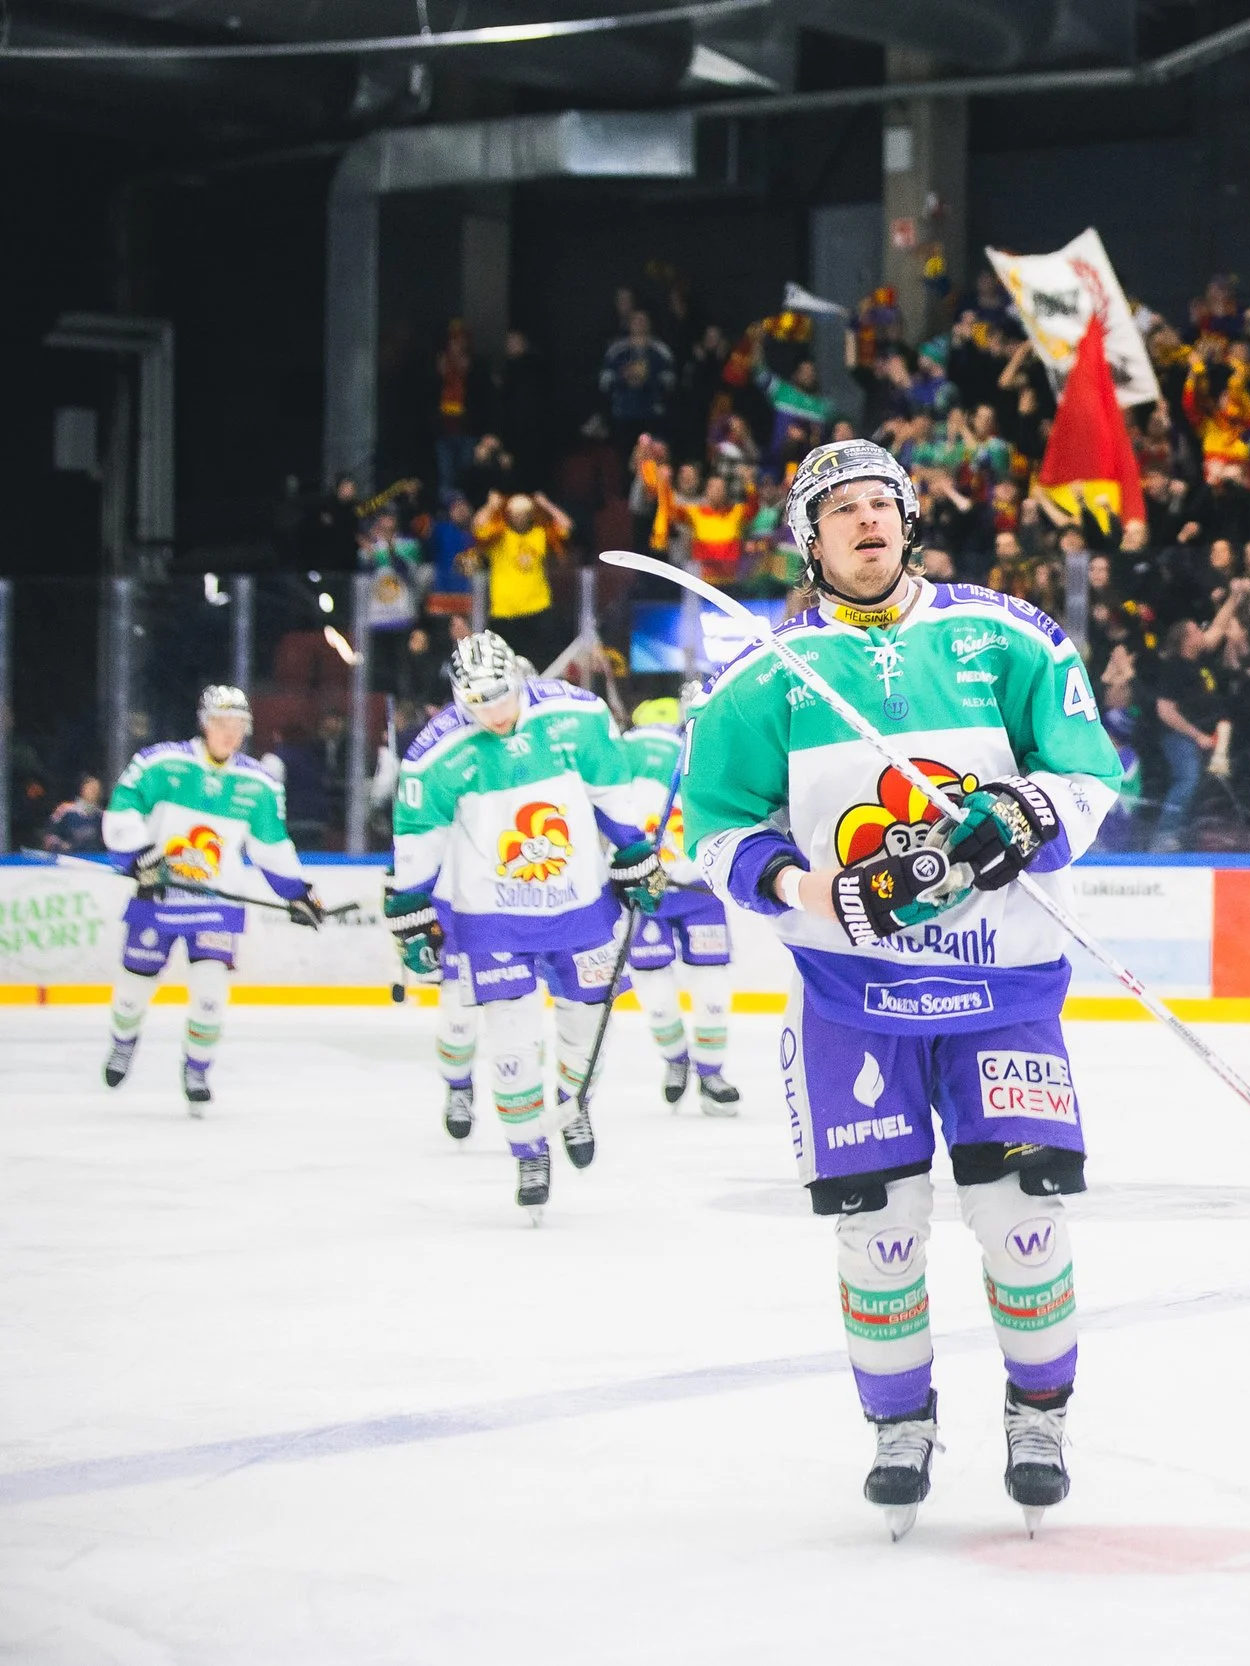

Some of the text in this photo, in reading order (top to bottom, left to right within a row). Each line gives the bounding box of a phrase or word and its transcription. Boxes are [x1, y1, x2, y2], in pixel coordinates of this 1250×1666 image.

[844, 609, 893, 623] HELSINKI
[1063, 666, 1098, 722] 4
[496, 882, 543, 908] Saldo
[924, 918, 997, 964] Bank
[878, 988, 919, 1014] JOHN
[981, 1057, 1072, 1088] CABLE
[988, 1086, 1071, 1115] CREW
[826, 1113, 913, 1150] INFUEL
[876, 1235, 914, 1263] W
[1013, 1225, 1052, 1256] W
